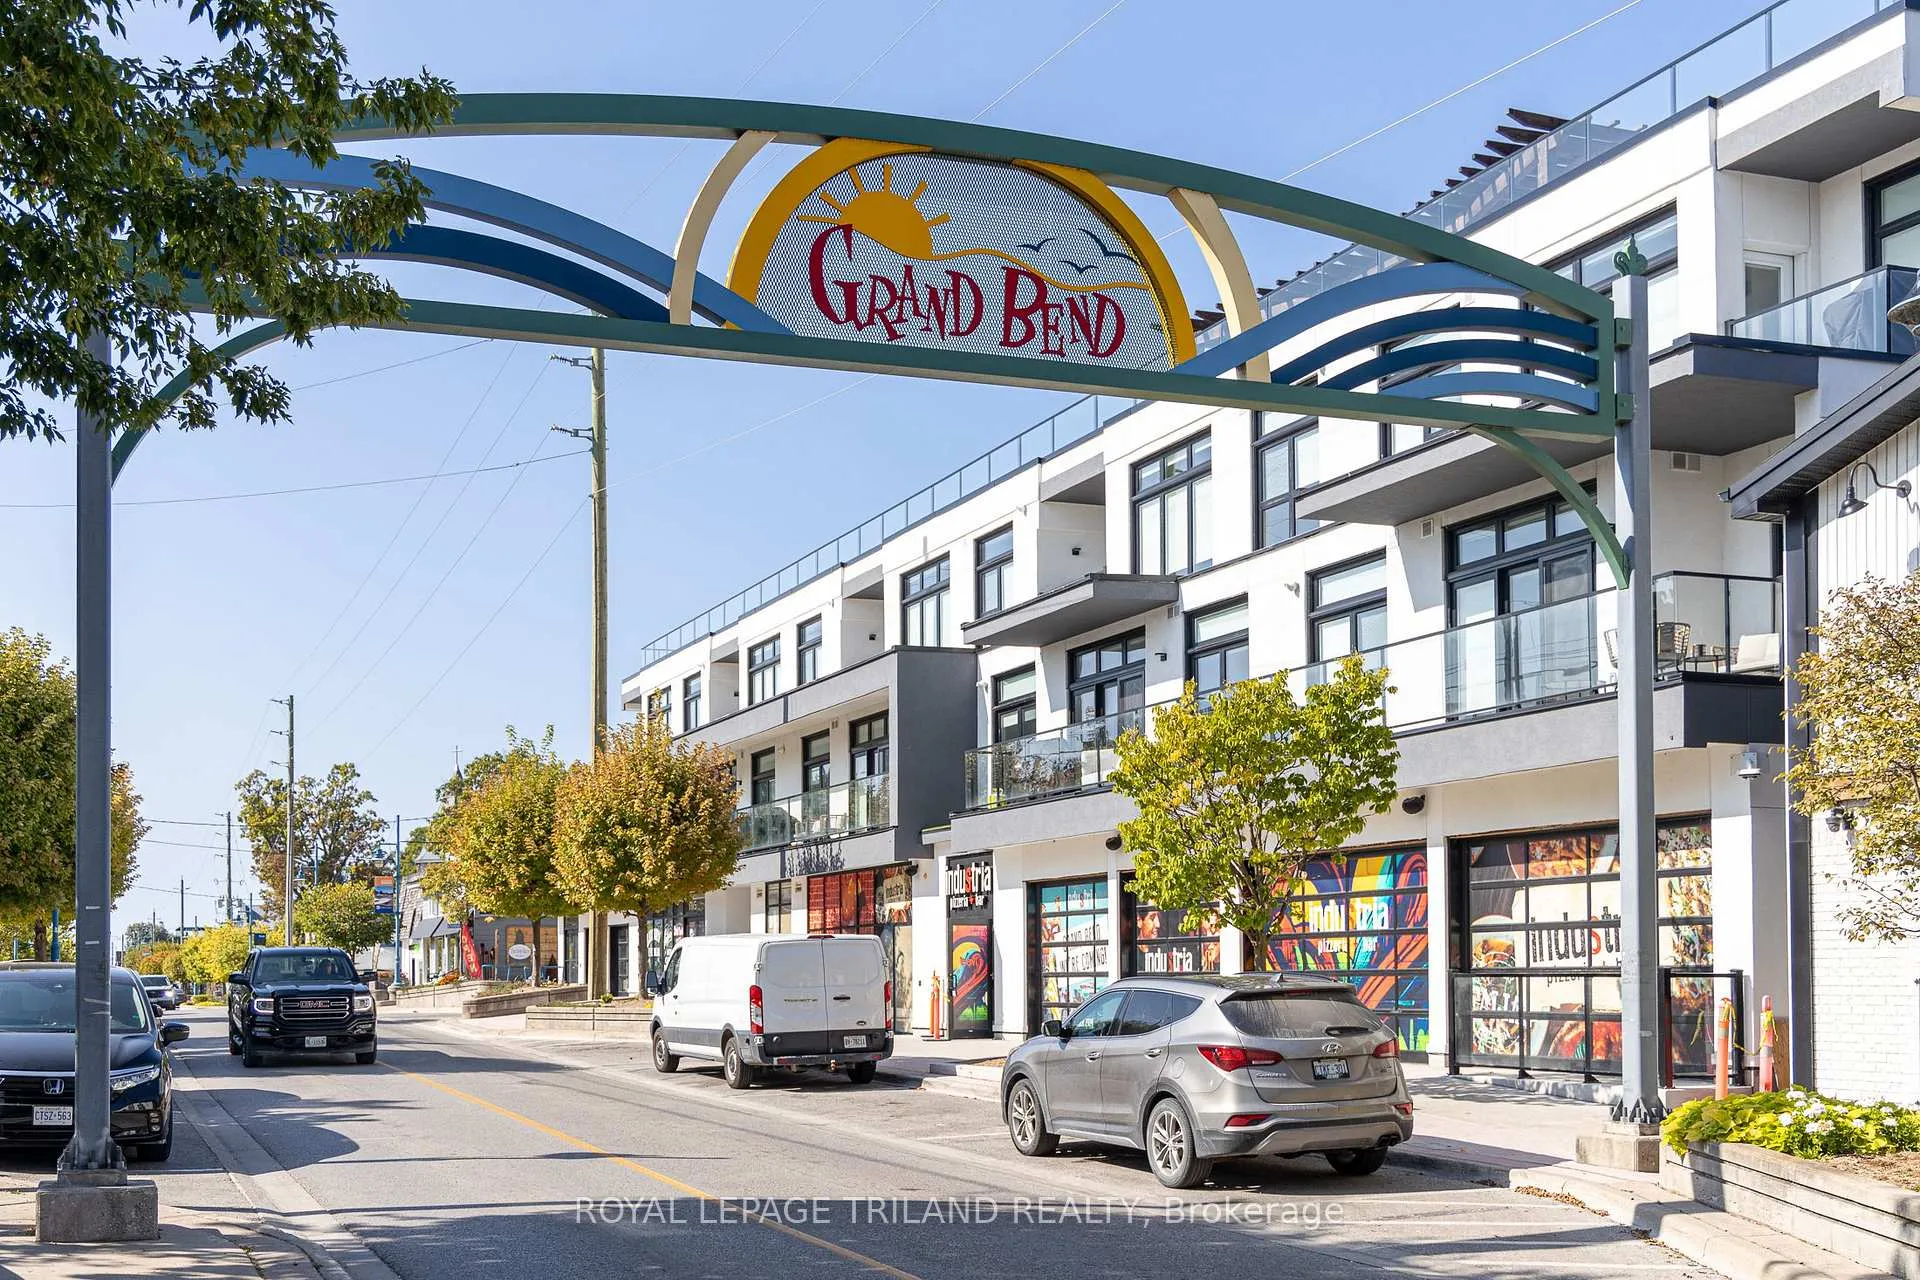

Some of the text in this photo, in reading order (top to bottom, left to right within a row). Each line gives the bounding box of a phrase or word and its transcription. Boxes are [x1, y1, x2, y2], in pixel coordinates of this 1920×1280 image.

[809, 224, 1126, 358] GRAND BEND
[945, 861, 991, 895] industria
[300, 1000, 330, 1008] GMC
